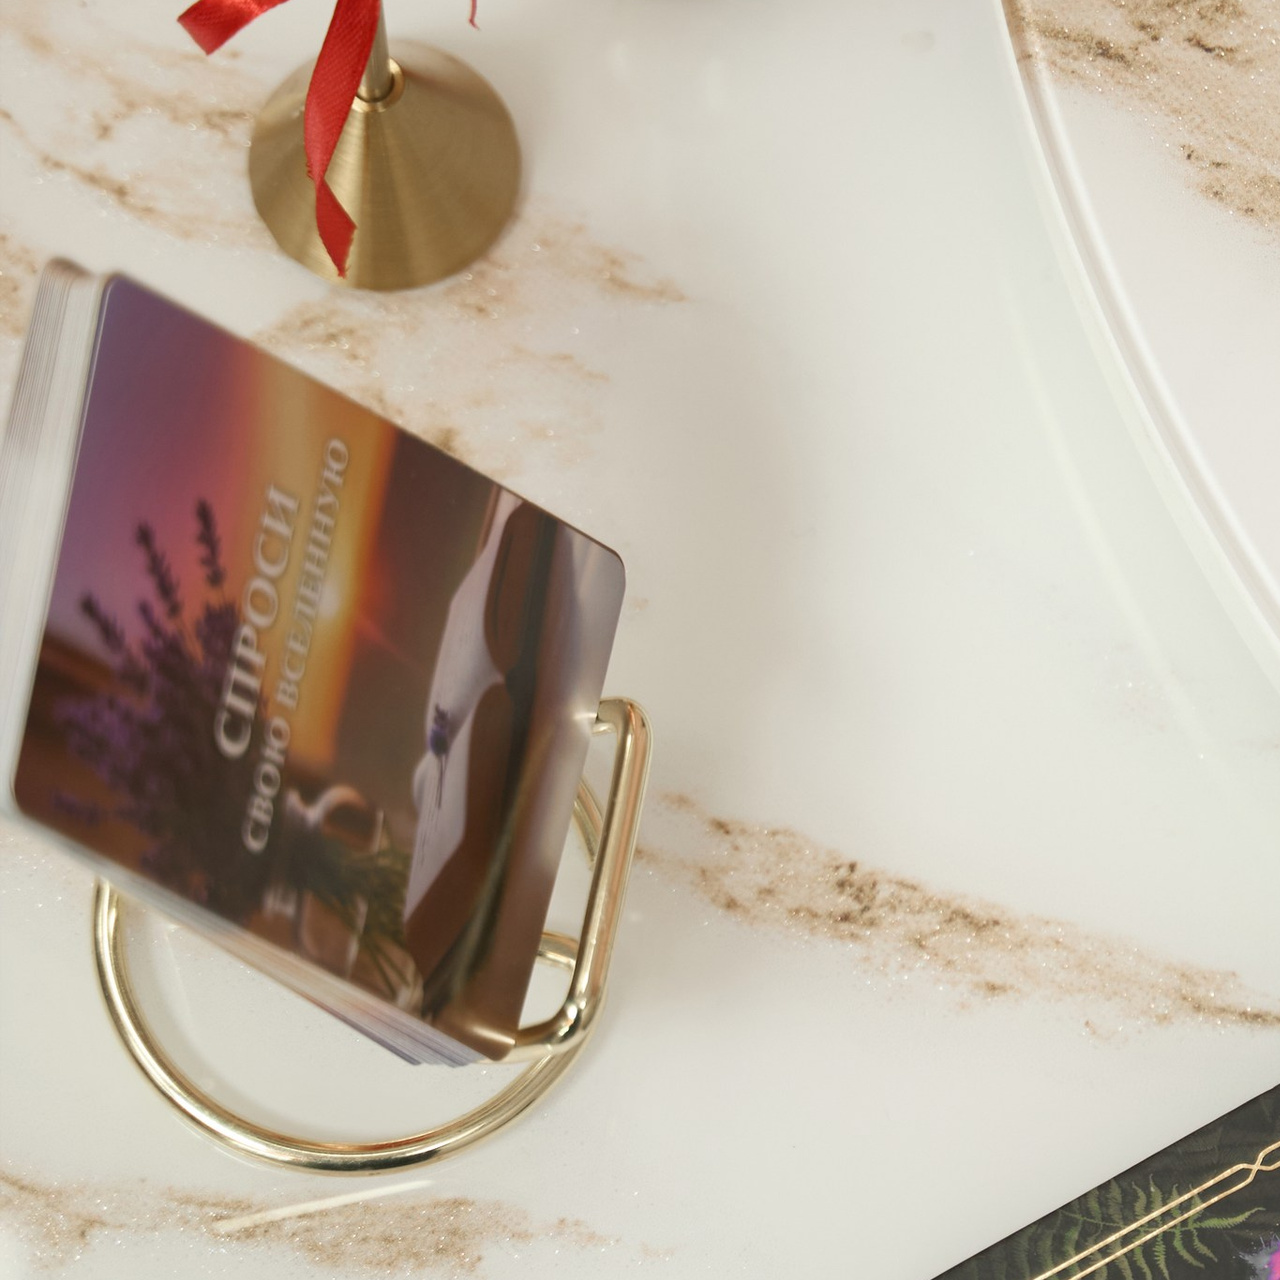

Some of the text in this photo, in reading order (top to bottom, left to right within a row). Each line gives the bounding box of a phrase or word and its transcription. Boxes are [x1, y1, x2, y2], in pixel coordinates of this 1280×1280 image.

[214, 483, 299, 760] СПРОСИ
[241, 437, 349, 854] СВОЮ ВСЕЛЕННУЮ
